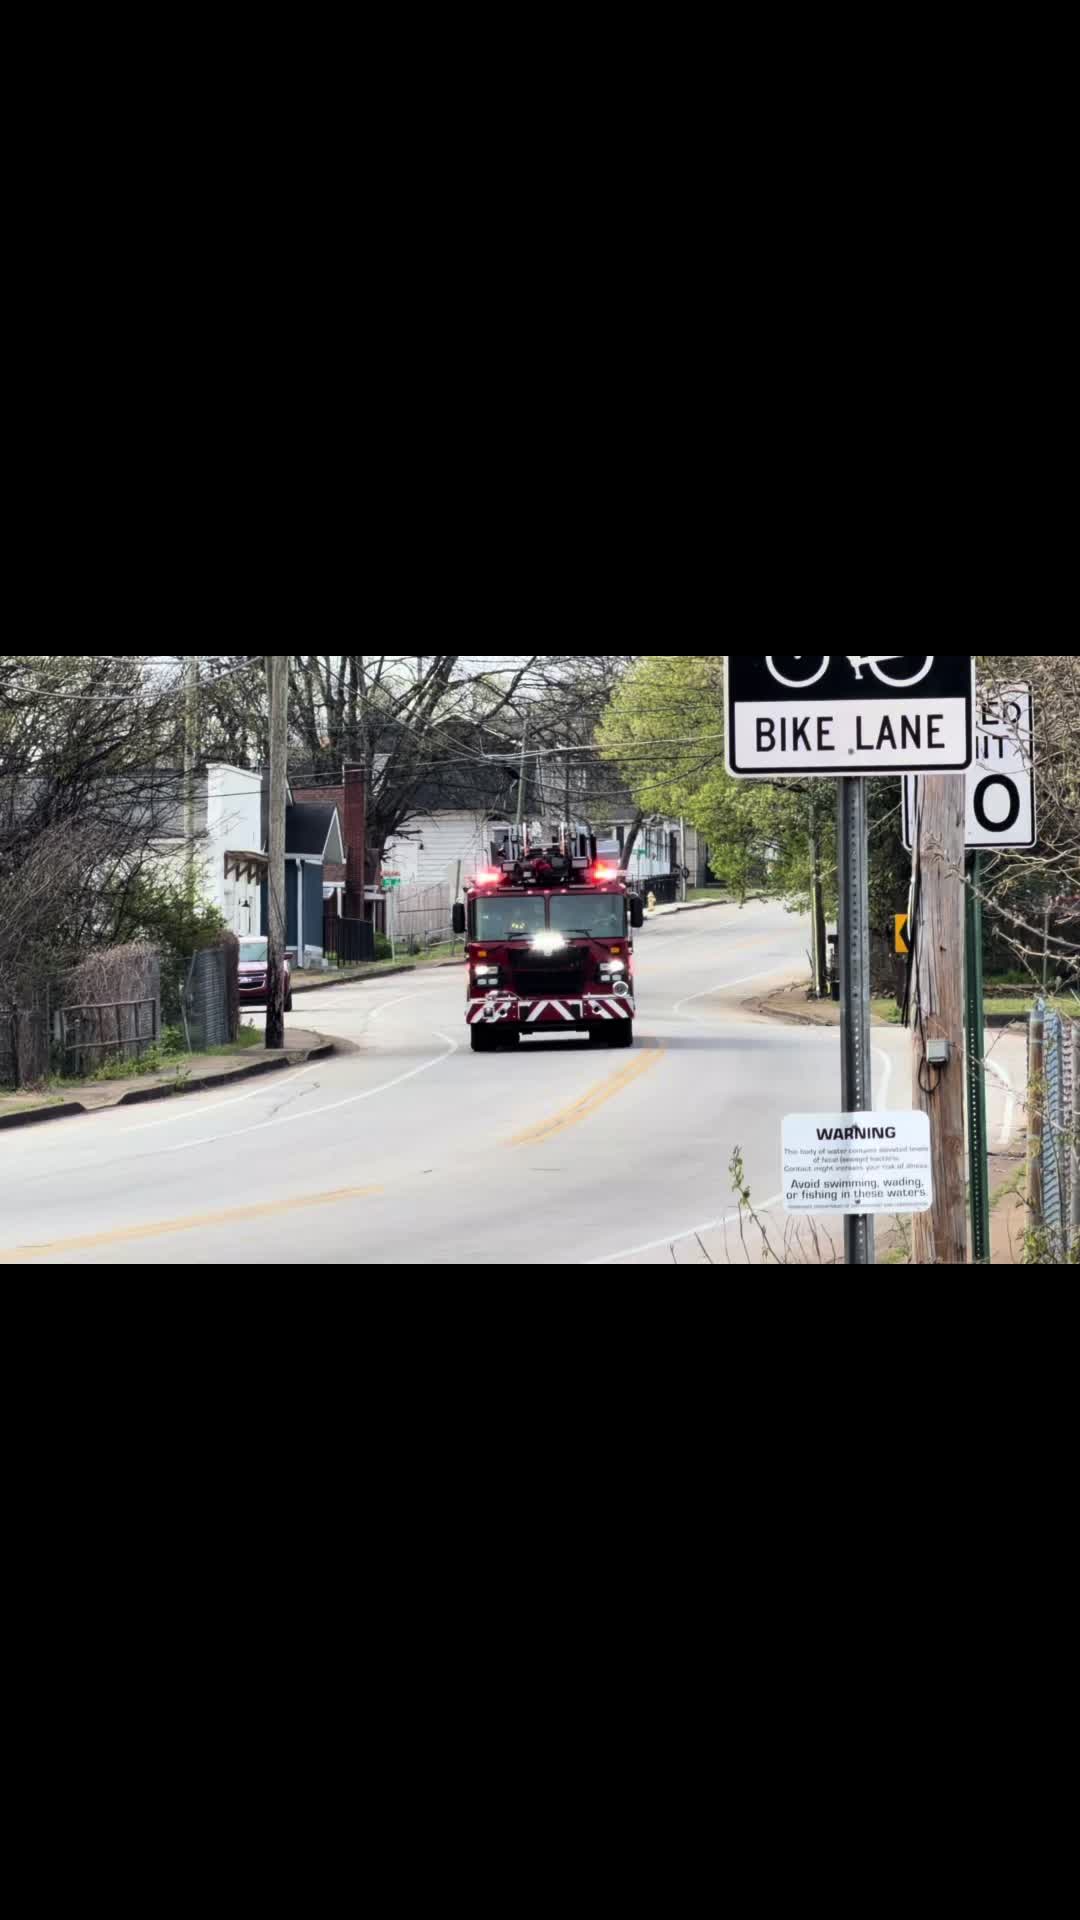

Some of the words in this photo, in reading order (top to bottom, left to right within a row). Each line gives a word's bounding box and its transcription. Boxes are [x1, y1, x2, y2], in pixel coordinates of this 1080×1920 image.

[976, 702, 1021, 725] ED
[756, 716, 835, 752] BIKE
[856, 714, 945, 750] LANE
[973, 774, 1020, 832] 0
[816, 1126, 896, 1140] WARNING
[791, 1179, 820, 1189] Avoid
[824, 1178, 880, 1190] swimming,
[883, 1177, 924, 1188] wading,
[802, 1190, 838, 1201] fishing
[841, 1190, 850, 1199] in
[854, 1189, 883, 1198] these
[887, 1188, 928, 1197] waters.
